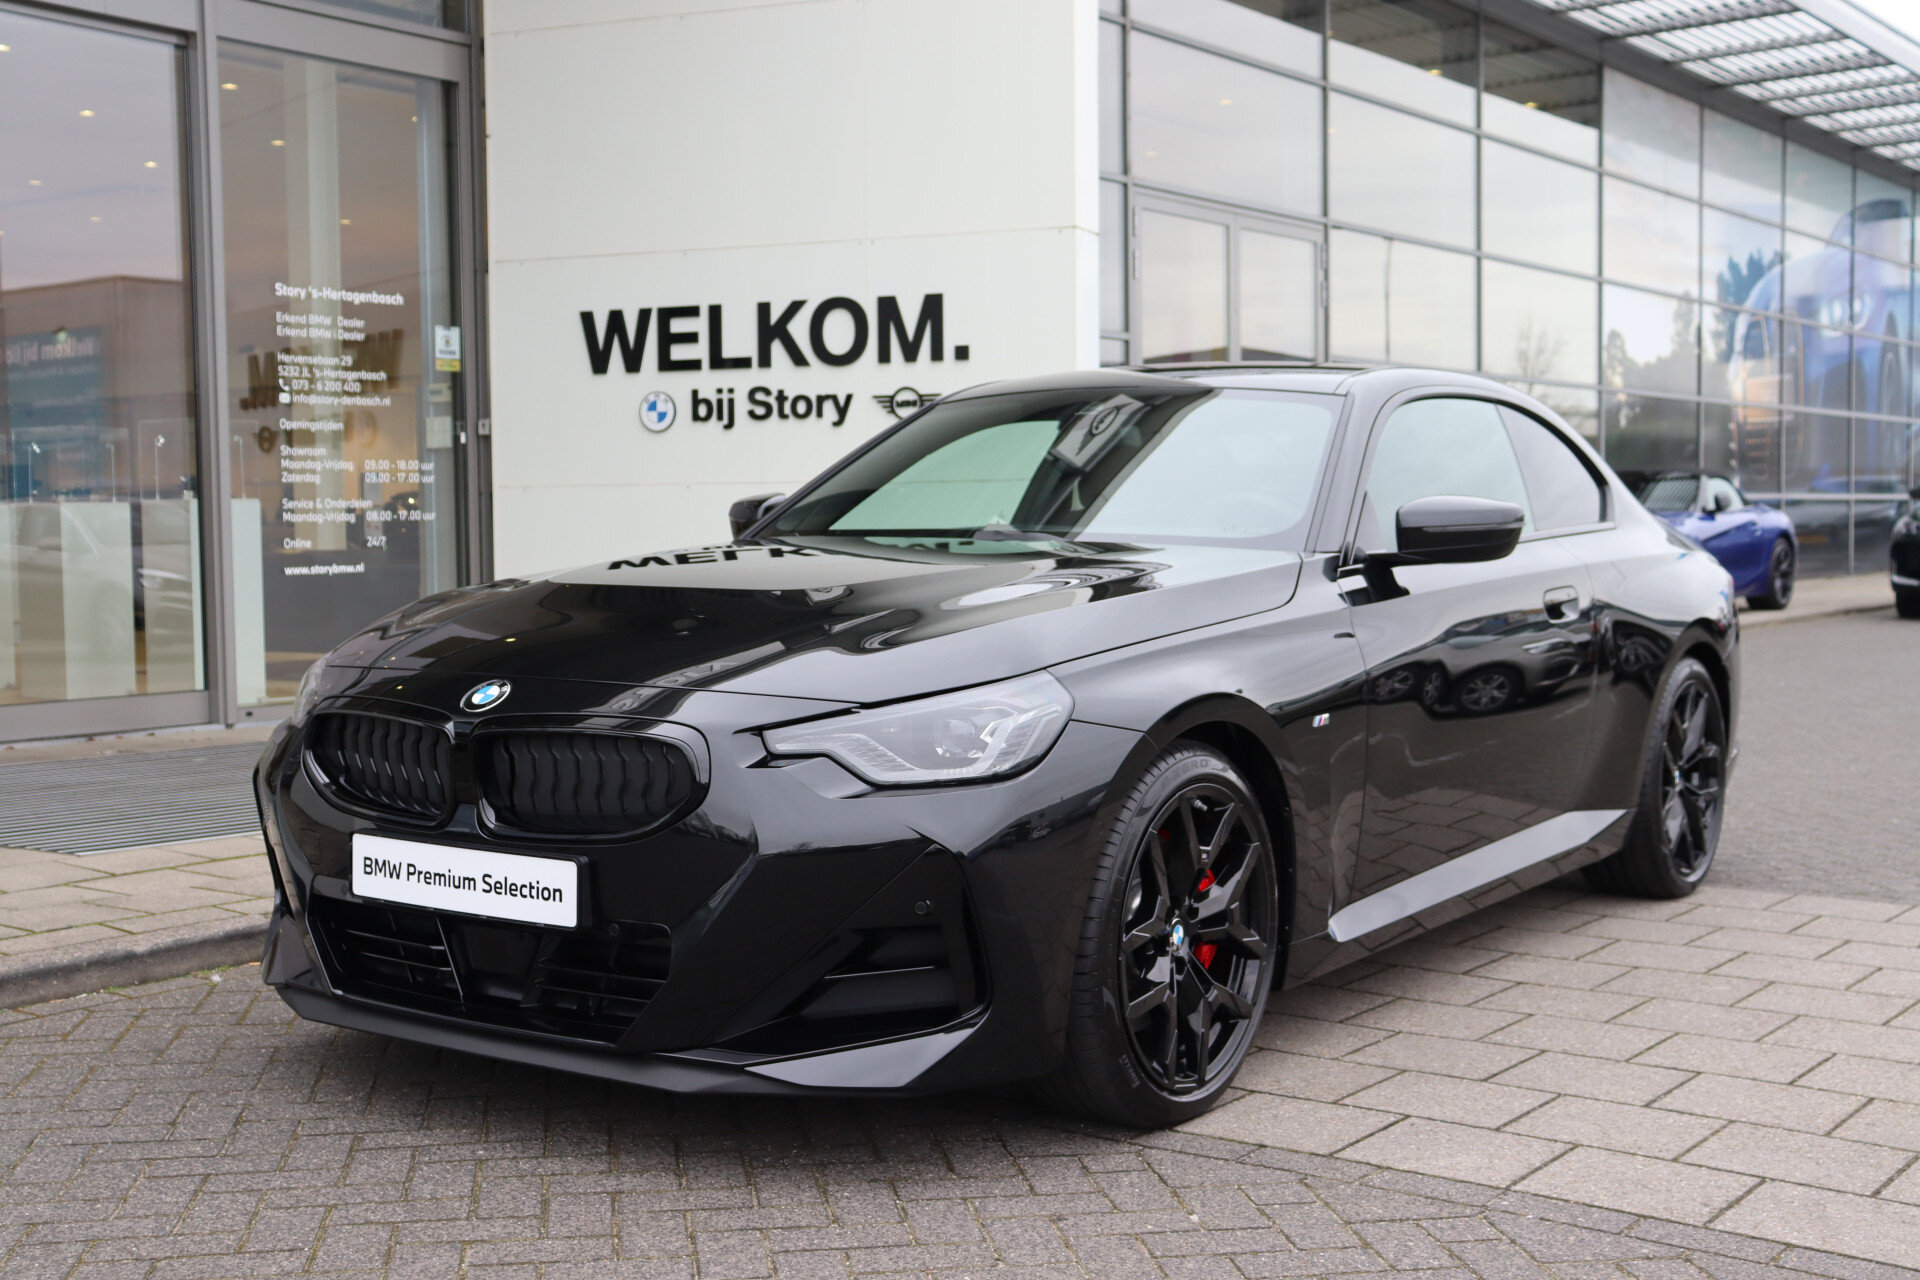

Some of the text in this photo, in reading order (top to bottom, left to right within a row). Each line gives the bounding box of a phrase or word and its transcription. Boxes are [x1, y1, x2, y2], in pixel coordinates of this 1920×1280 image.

[275, 282, 306, 300] Story
[276, 311, 366, 328] Erkend BMW Dealer
[277, 325, 307, 338] Erkend
[309, 327, 332, 339] BMW
[338, 329, 366, 341] Dealer
[580, 293, 970, 375] WELKOM.
[340, 355, 353, 367] 29
[278, 365, 300, 377] 5232
[301, 366, 311, 378] JL
[292, 379, 309, 390] 073
[316, 380, 323, 391] 6
[324, 380, 342, 392] 200
[343, 381, 361, 393] 400
[691, 386, 853, 429] bij Story
[279, 418, 344, 432] Openingstijden
[280, 445, 326, 456] Showroom
[281, 458, 354, 472] Maandag-Vrijdag
[364, 459, 390, 471] 09.00
[397, 459, 419, 471] 18.00
[420, 461, 435, 471] uur
[281, 472, 321, 485] Zaterdag
[365, 472, 390, 483] 09.00
[397, 472, 420, 483] 17.00
[421, 473, 435, 483] uur
[282, 497, 373, 510] Service & Onderdelen
[282, 511, 356, 524] Maandag-Vrijdag
[366, 510, 391, 521] 08.00
[398, 510, 421, 521] 17.00
[422, 511, 436, 521] uur
[283, 536, 387, 549] Online 24/7
[284, 562, 365, 576] www.storybmw.nl
[363, 856, 563, 903] BMW Premium Selection
